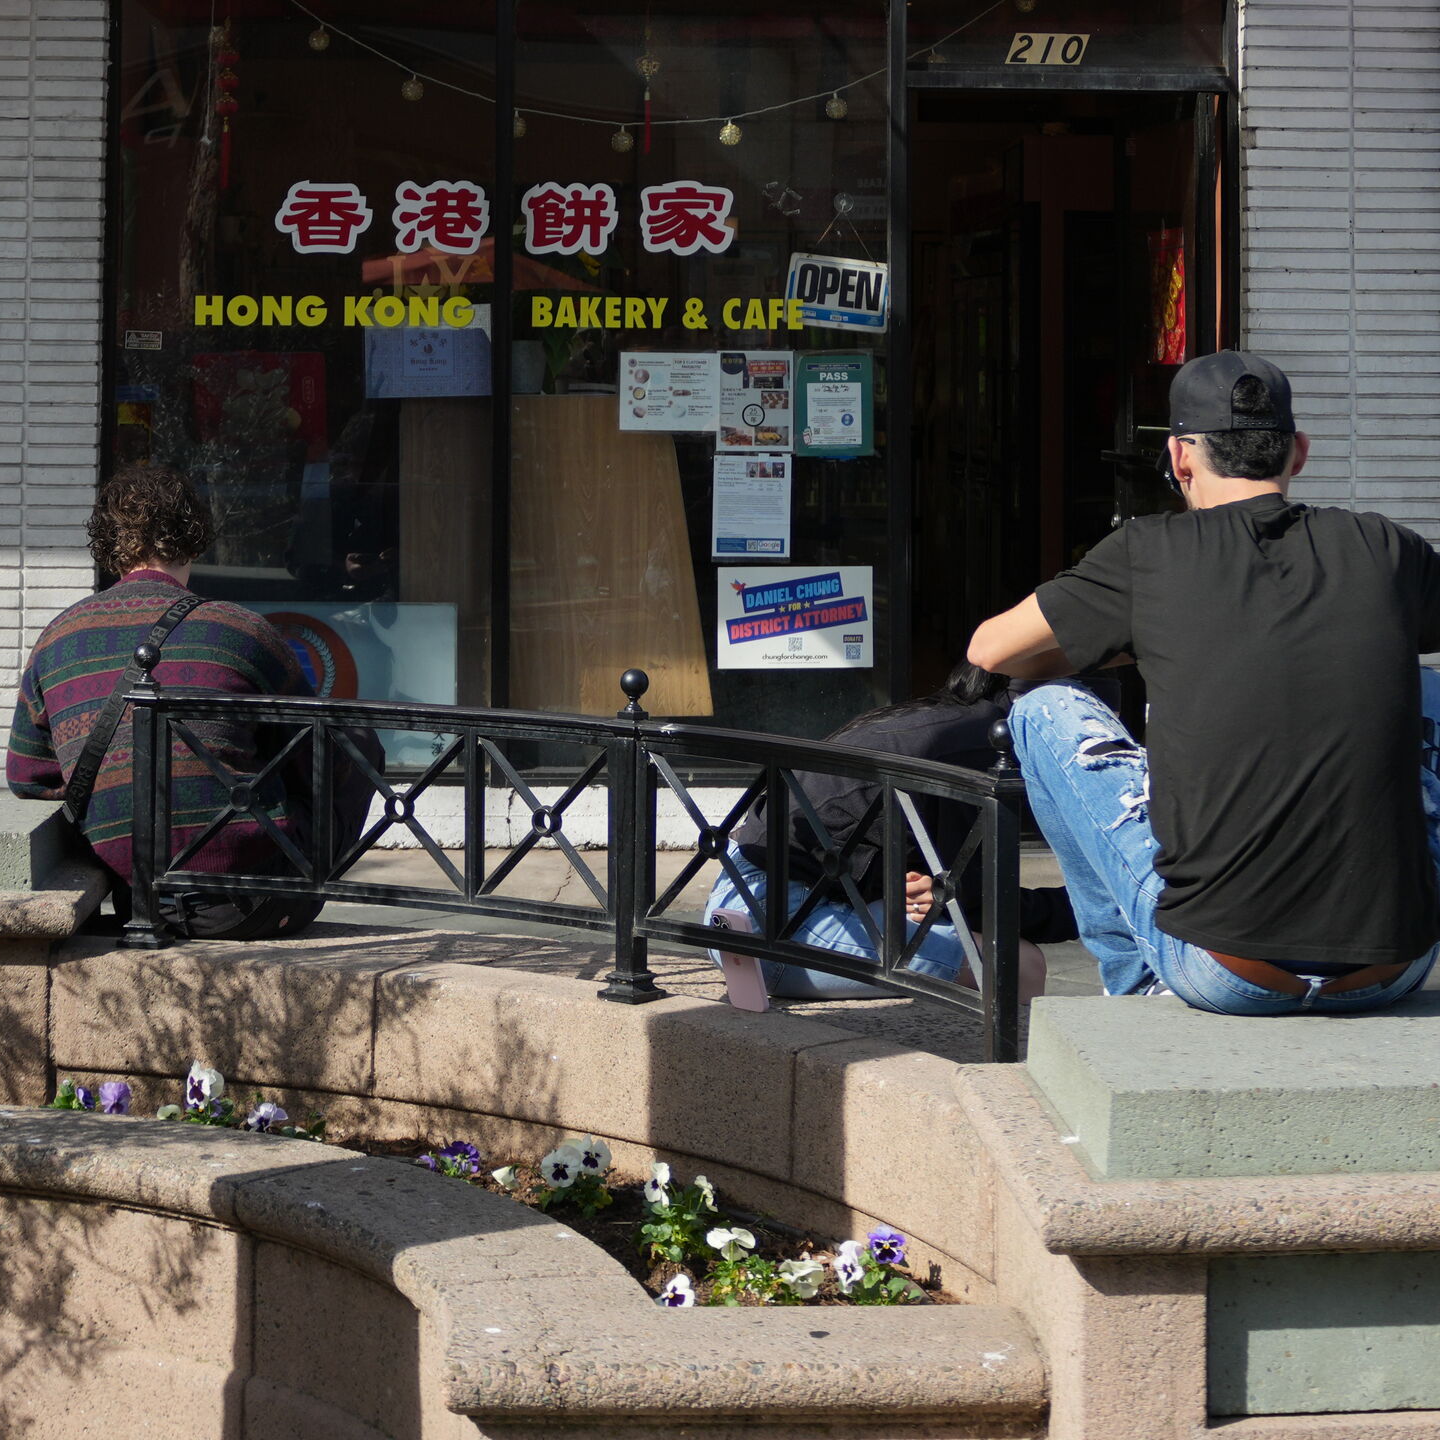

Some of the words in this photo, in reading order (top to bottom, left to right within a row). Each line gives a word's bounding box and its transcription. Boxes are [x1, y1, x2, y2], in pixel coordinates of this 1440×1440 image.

[1008, 35, 1084, 65] 210
[275, 179, 735, 256] 香港餅家
[796, 263, 883, 312] OPEN
[195, 296, 329, 328] HONG
[344, 296, 476, 329] KONG
[532, 297, 669, 330] BAKERY
[683, 298, 708, 331] &
[723, 298, 805, 331] CAFE
[819, 371, 849, 381] PASS
[745, 587, 793, 609] DANIEL
[796, 578, 840, 598] CHUNG
[788, 603, 802, 612] FOR
[730, 615, 791, 640] DISTRICT
[794, 602, 865, 629] ATTORNEY
[761, 652, 828, 661] chungforchange.com
